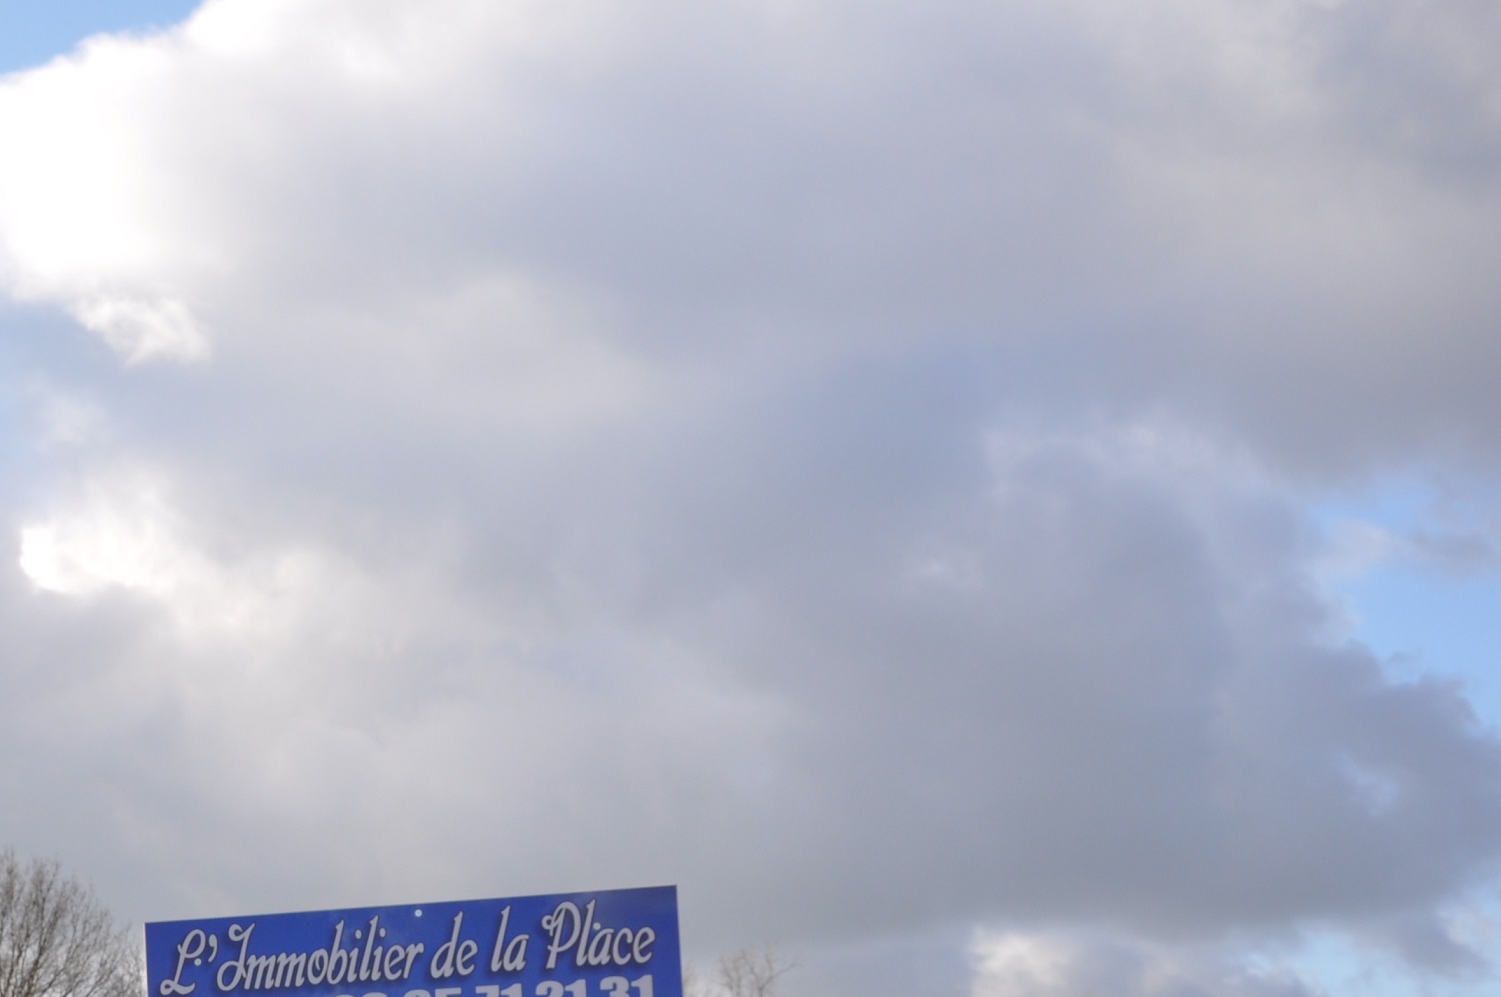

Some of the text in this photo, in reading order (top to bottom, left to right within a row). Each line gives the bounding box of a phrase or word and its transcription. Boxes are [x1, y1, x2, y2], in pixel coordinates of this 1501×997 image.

[160, 900, 656, 996] L'Immobilier de la Place
